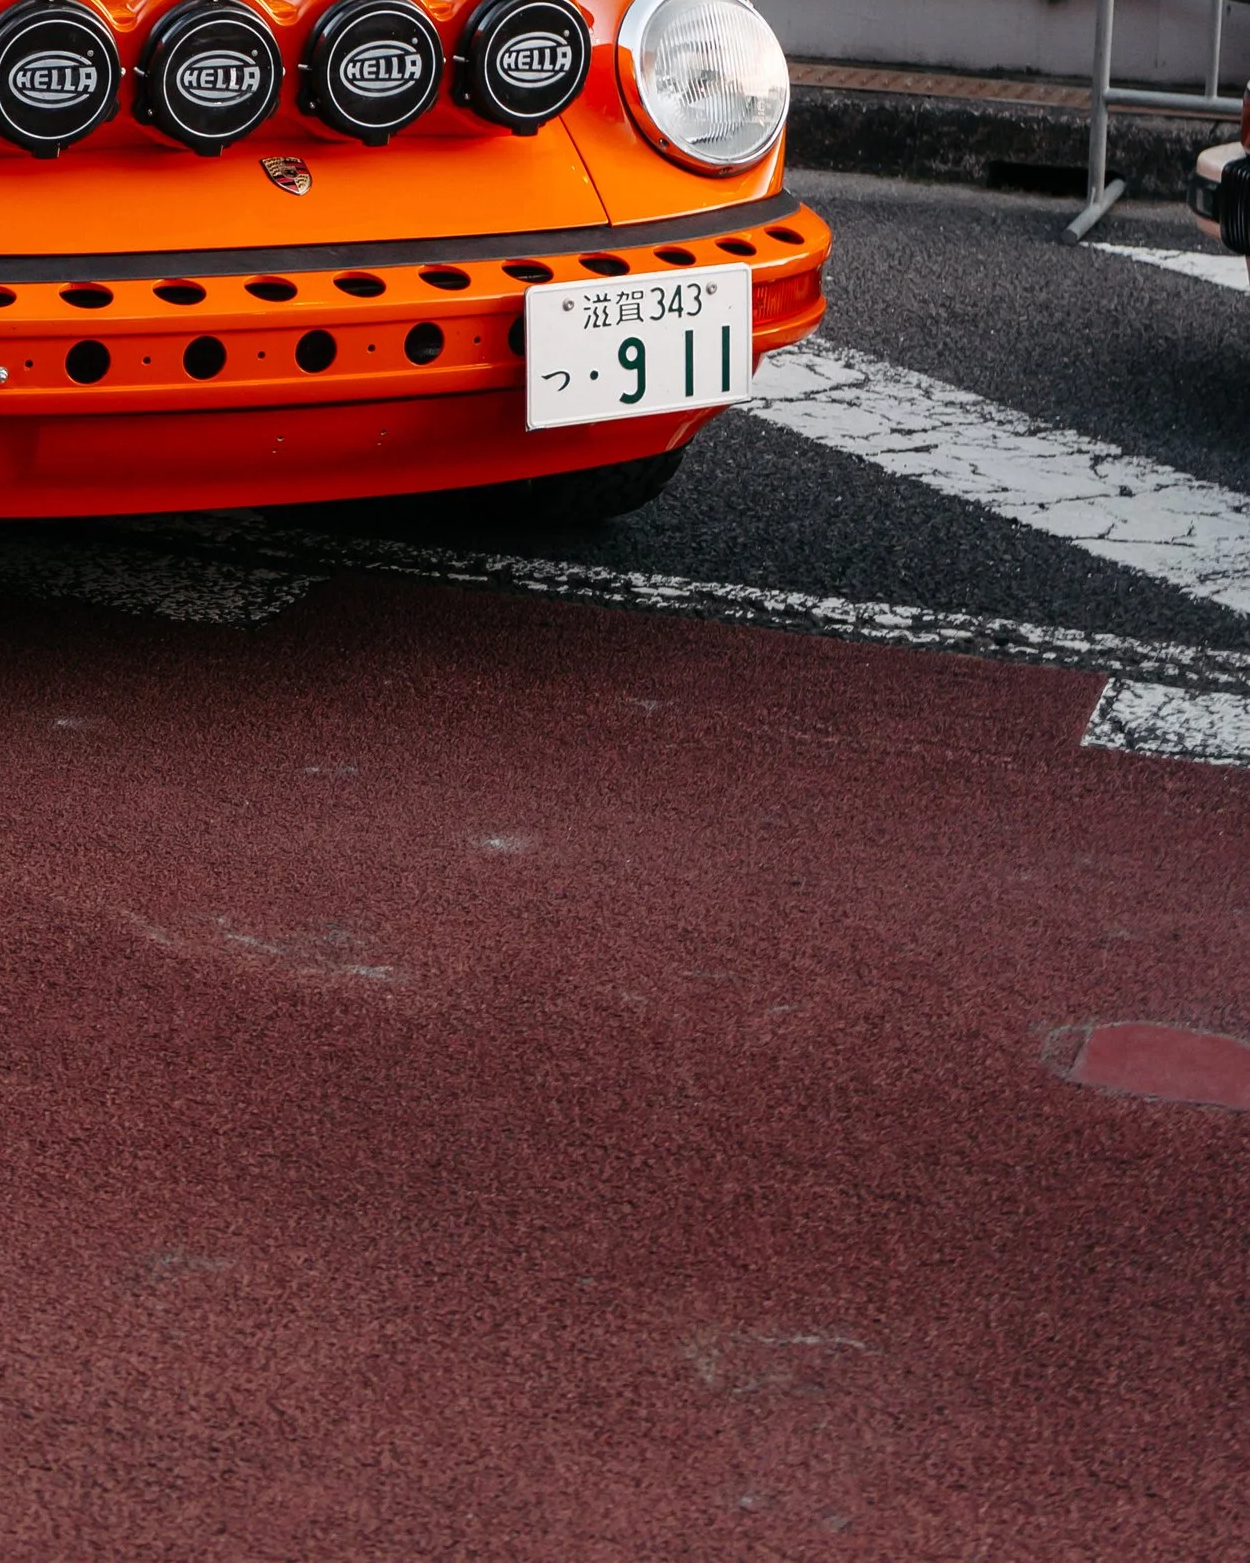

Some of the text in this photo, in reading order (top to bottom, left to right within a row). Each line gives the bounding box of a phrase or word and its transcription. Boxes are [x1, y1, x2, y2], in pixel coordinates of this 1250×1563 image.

[347, 53, 423, 81] HELLA
[499, 45, 572, 74] HELLA
[16, 66, 98, 93] HELLA
[184, 66, 261, 93] HELLA
